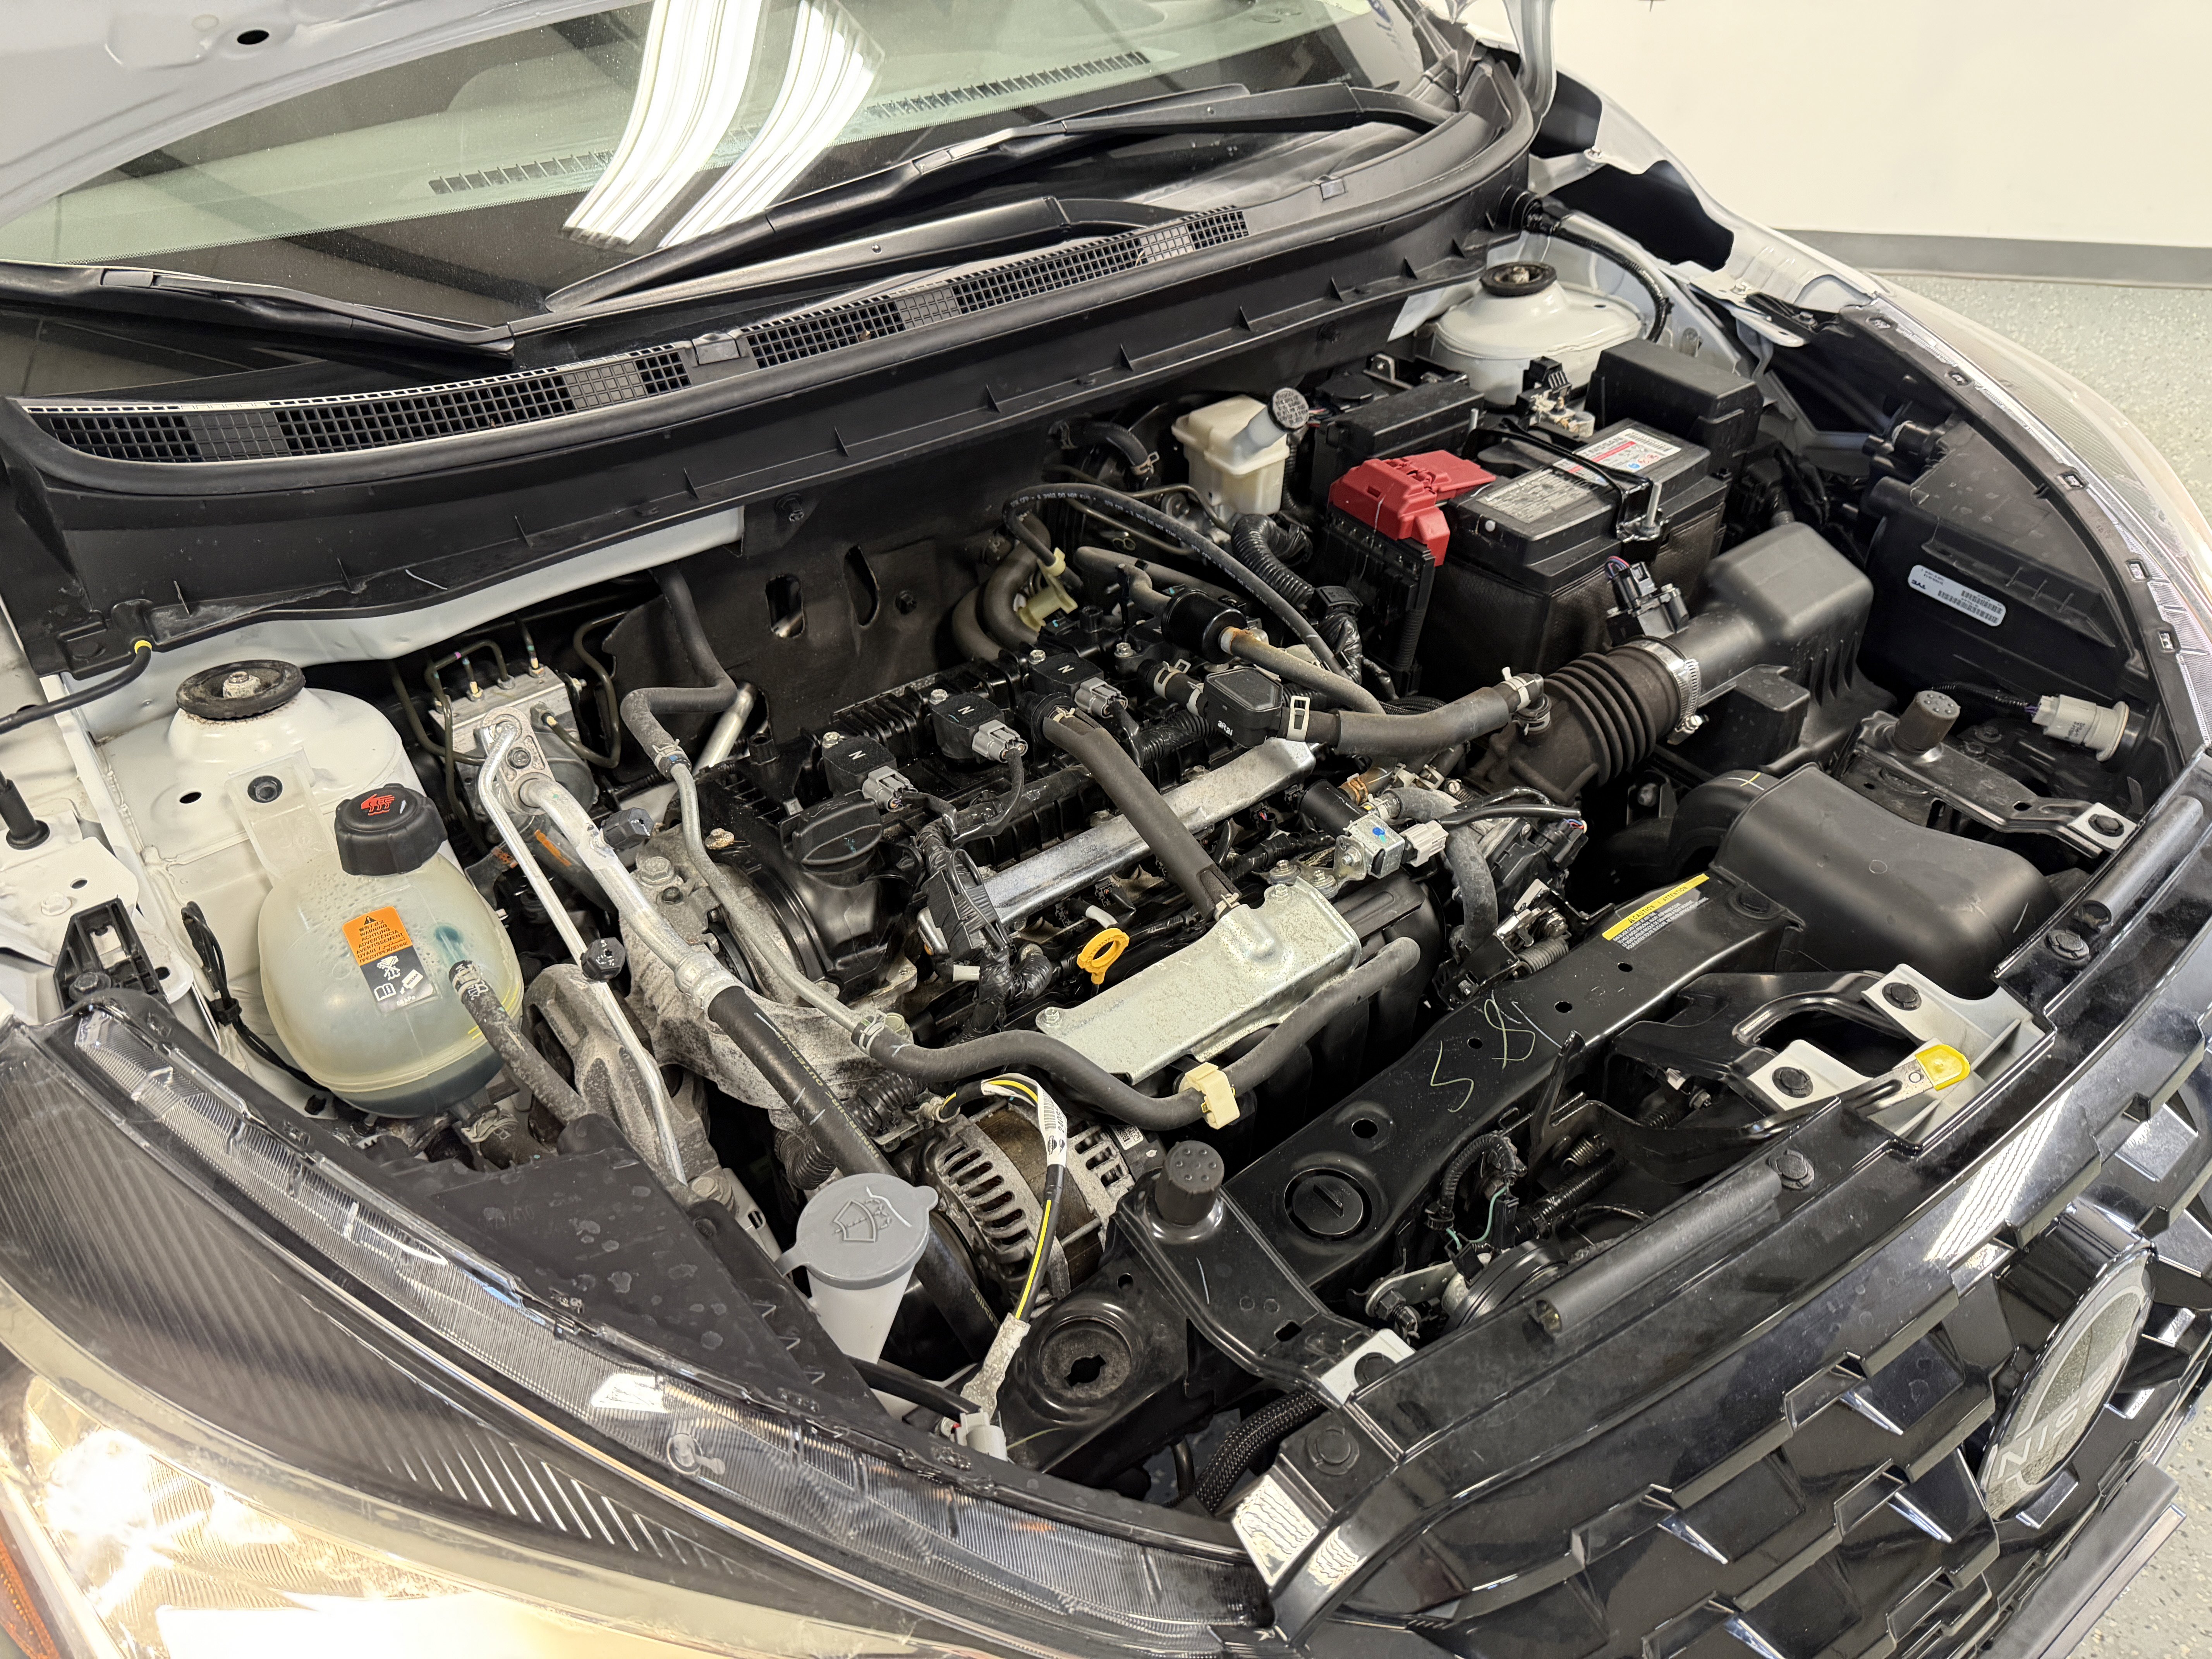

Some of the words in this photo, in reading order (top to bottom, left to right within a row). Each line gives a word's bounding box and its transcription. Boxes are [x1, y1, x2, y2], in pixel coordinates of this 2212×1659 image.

[1632, 905, 1655, 920] CAUTION
[1662, 886, 1688, 902] ATTENTION
[360, 924, 388, 936] WARNING
[362, 928, 390, 941] ACHTUNG
[356, 933, 404, 954] AVERTISSEMENT
[357, 949, 376, 958] UYARI
[1997, 1367, 2109, 1480] NISS
